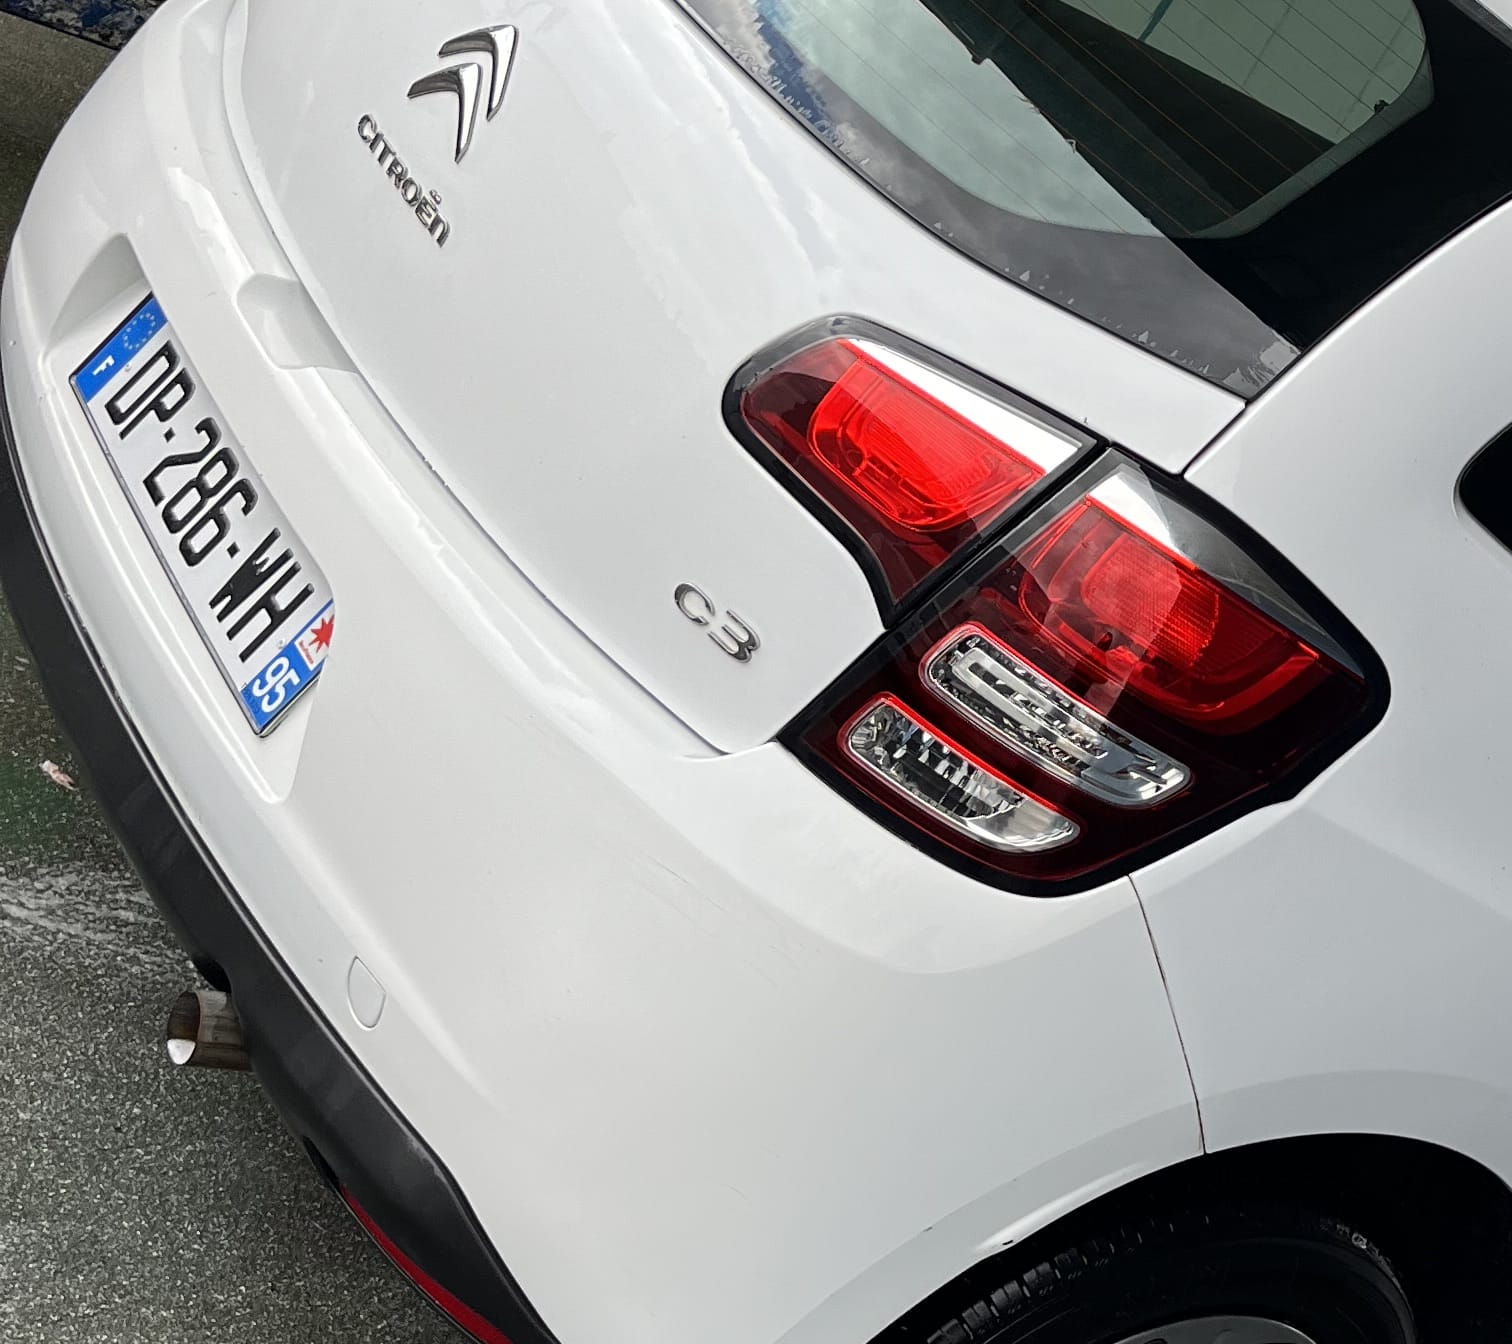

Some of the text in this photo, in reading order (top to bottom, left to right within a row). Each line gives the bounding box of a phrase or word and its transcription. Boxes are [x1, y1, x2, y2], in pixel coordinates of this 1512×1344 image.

[92, 355, 114, 376] F
[104, 340, 315, 663] DP-286-WH
[673, 580, 762, 664] C3
[252, 656, 300, 713] 95
